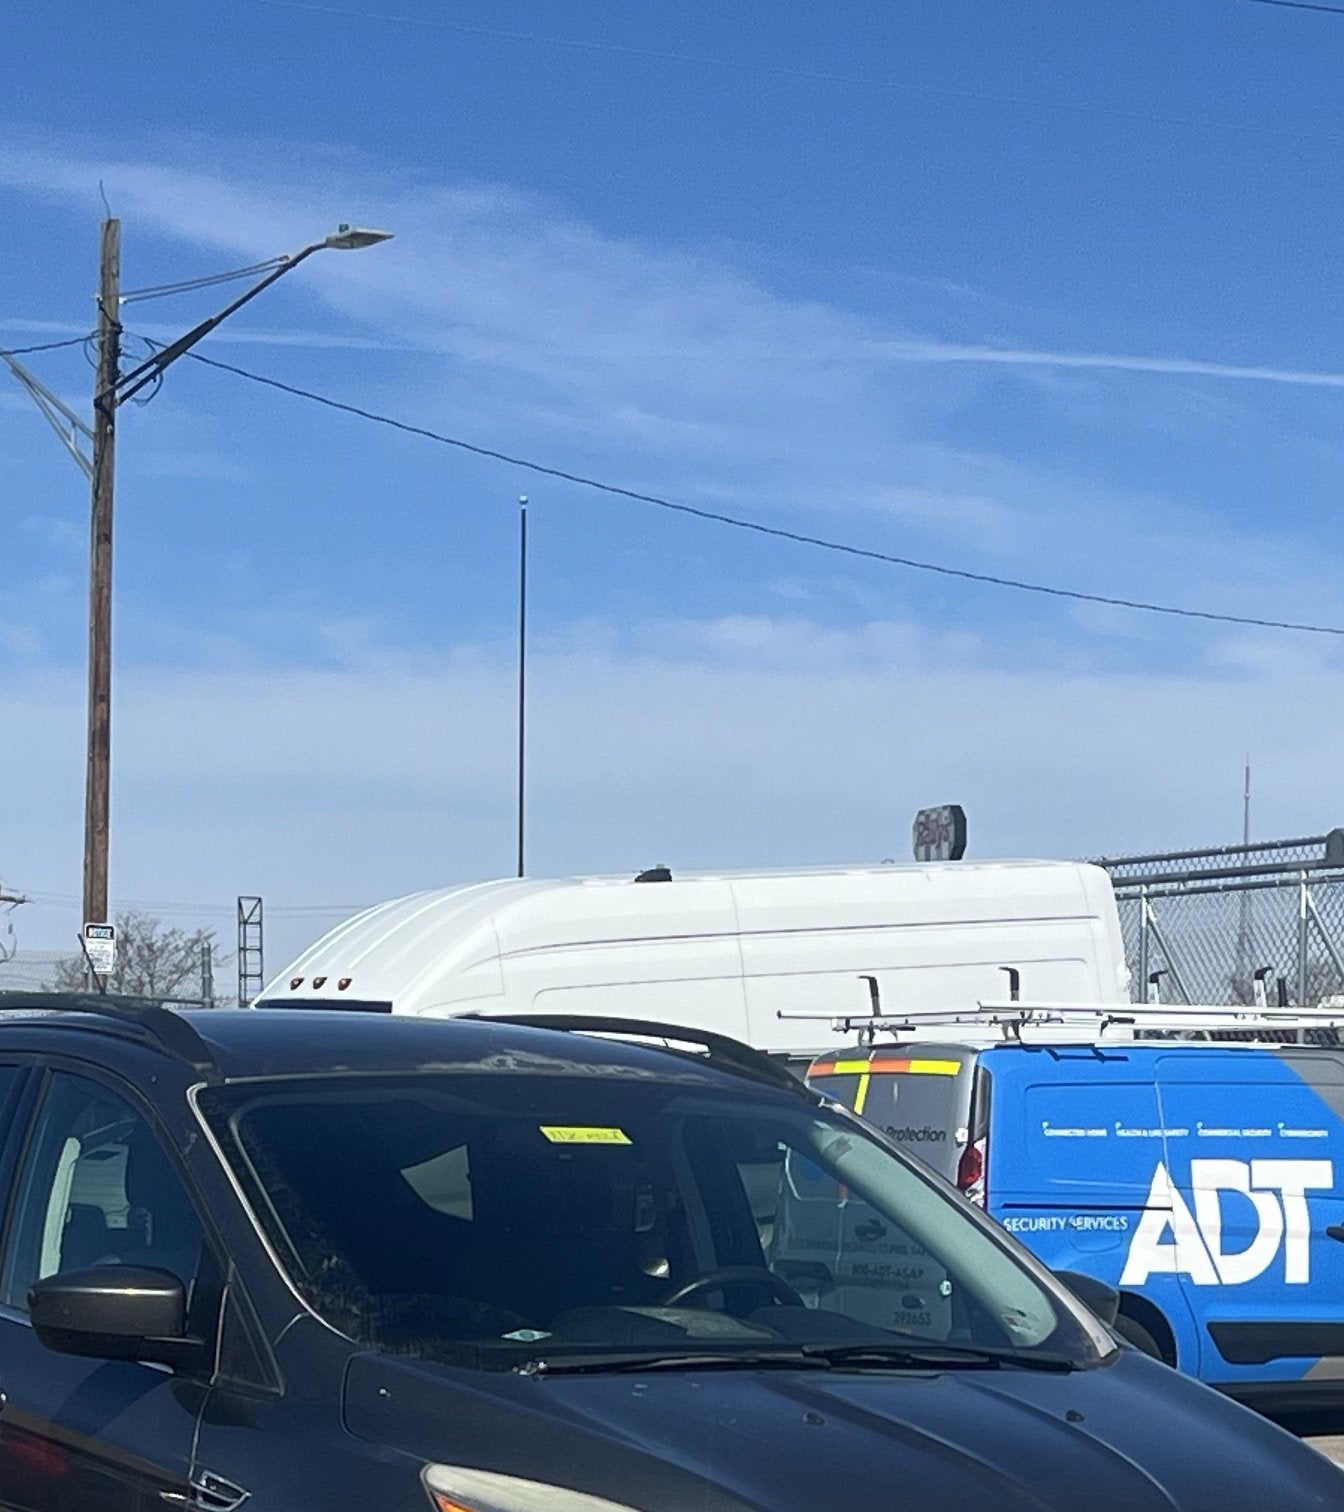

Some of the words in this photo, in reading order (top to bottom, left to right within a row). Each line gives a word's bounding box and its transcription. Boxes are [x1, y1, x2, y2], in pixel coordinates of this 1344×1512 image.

[1003, 1216, 1067, 1233] SECURITY
[1068, 1215, 1128, 1232] SERVICES
[1119, 1158, 1334, 1286] ADT
